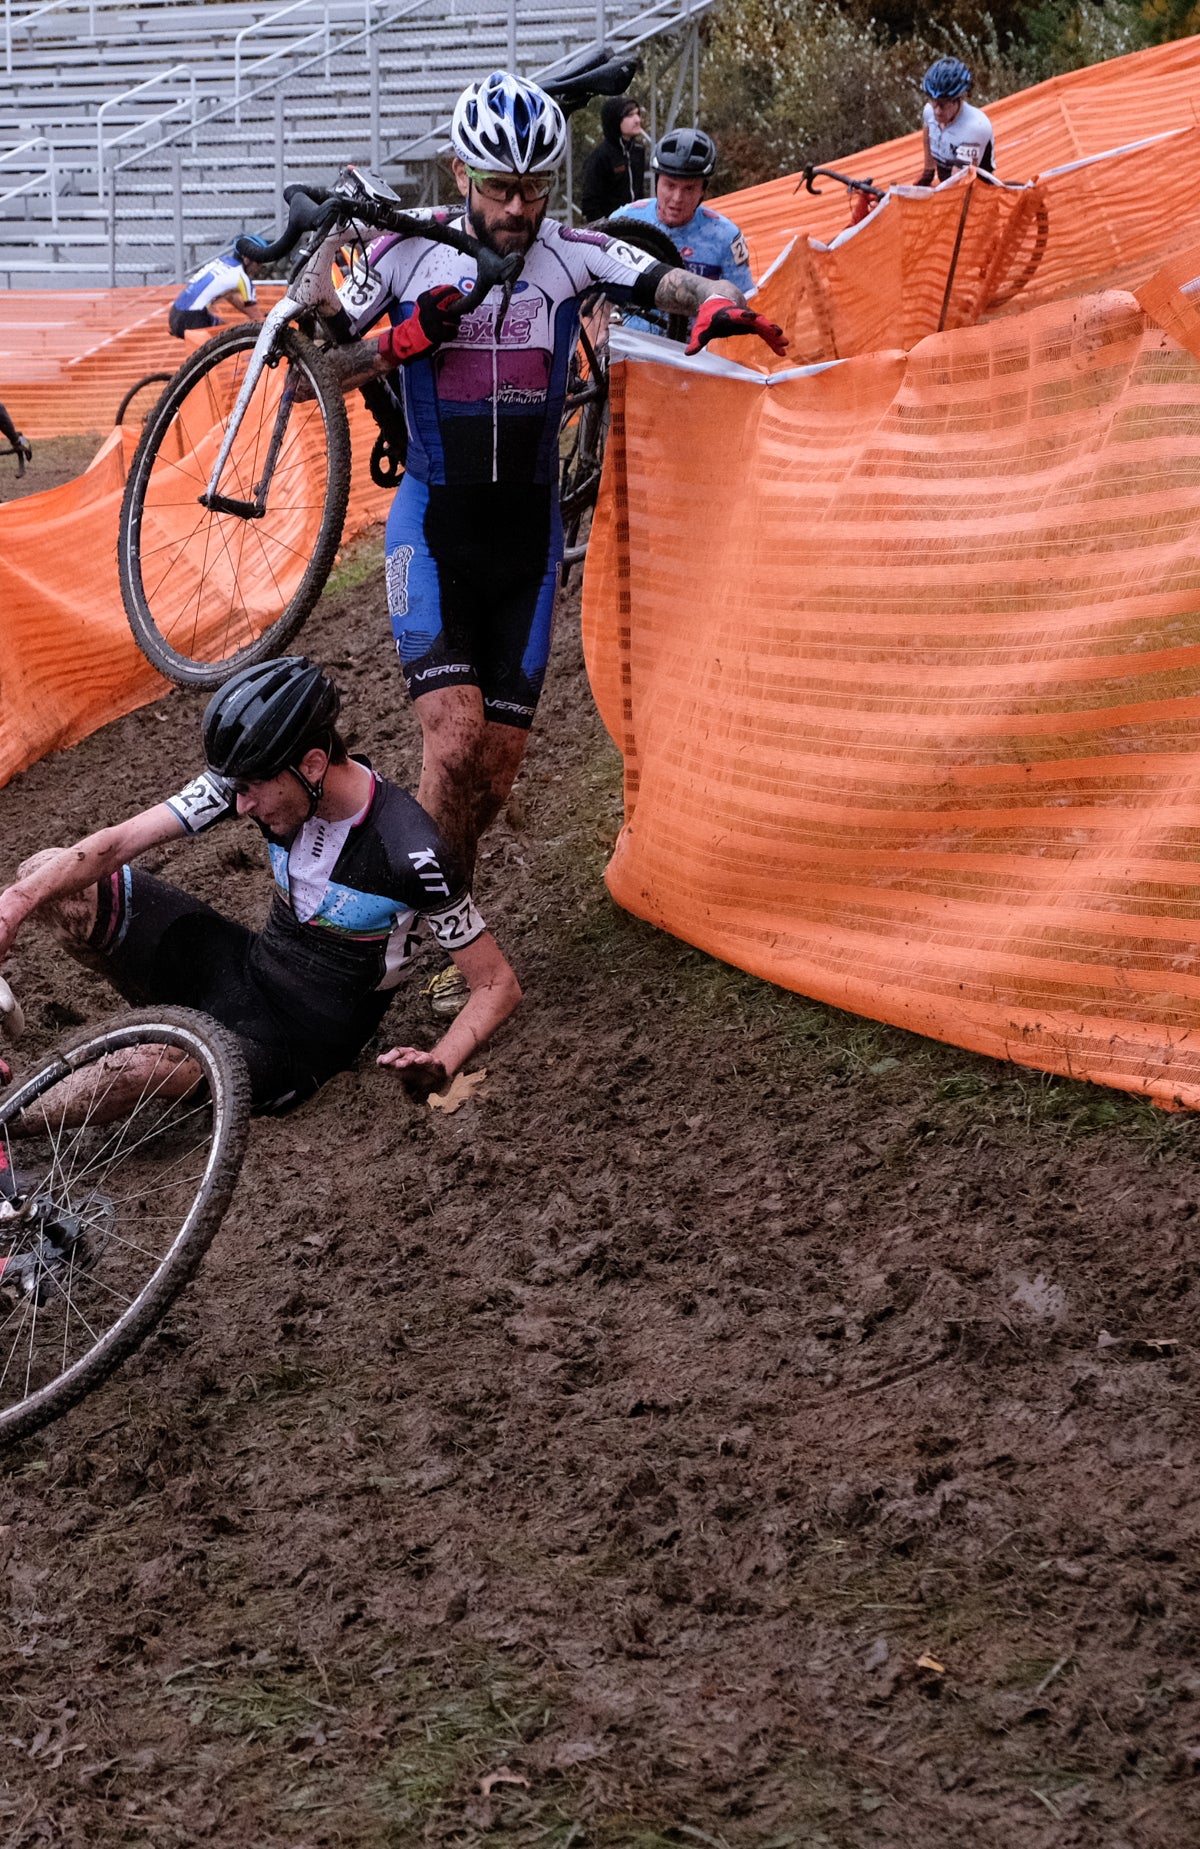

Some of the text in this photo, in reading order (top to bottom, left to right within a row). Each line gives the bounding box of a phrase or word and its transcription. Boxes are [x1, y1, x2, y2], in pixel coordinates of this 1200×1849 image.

[415, 663, 471, 682] VERGE
[176, 783, 221, 816] 27
[407, 846, 451, 898] KIT
[429, 902, 473, 942] 227
